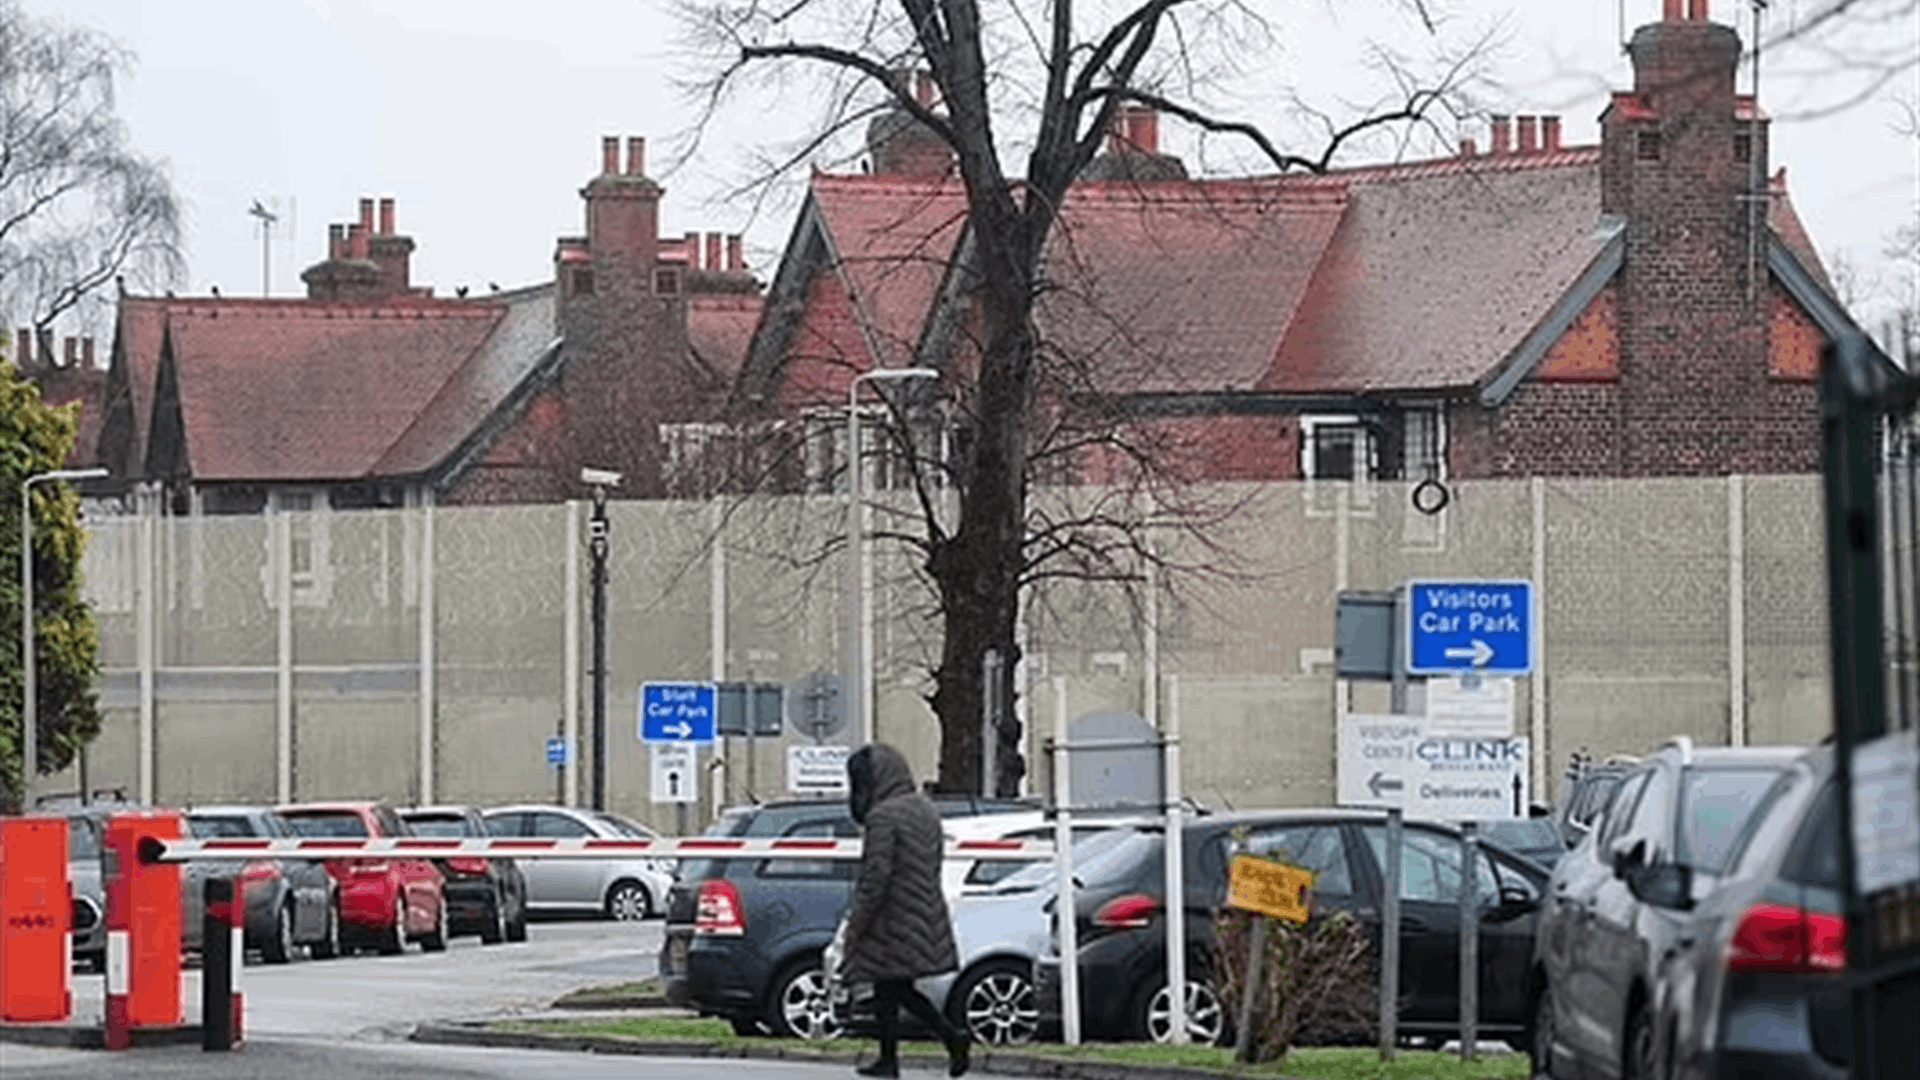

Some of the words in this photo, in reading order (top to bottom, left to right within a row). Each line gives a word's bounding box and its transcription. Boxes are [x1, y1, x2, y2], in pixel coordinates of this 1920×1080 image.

[1426, 588, 1513, 609] Visitors
[1419, 611, 1460, 633] Car
[1468, 611, 1520, 633] Park
[1415, 740, 1523, 761] CLINK
[1420, 783, 1502, 799] Deliveries
